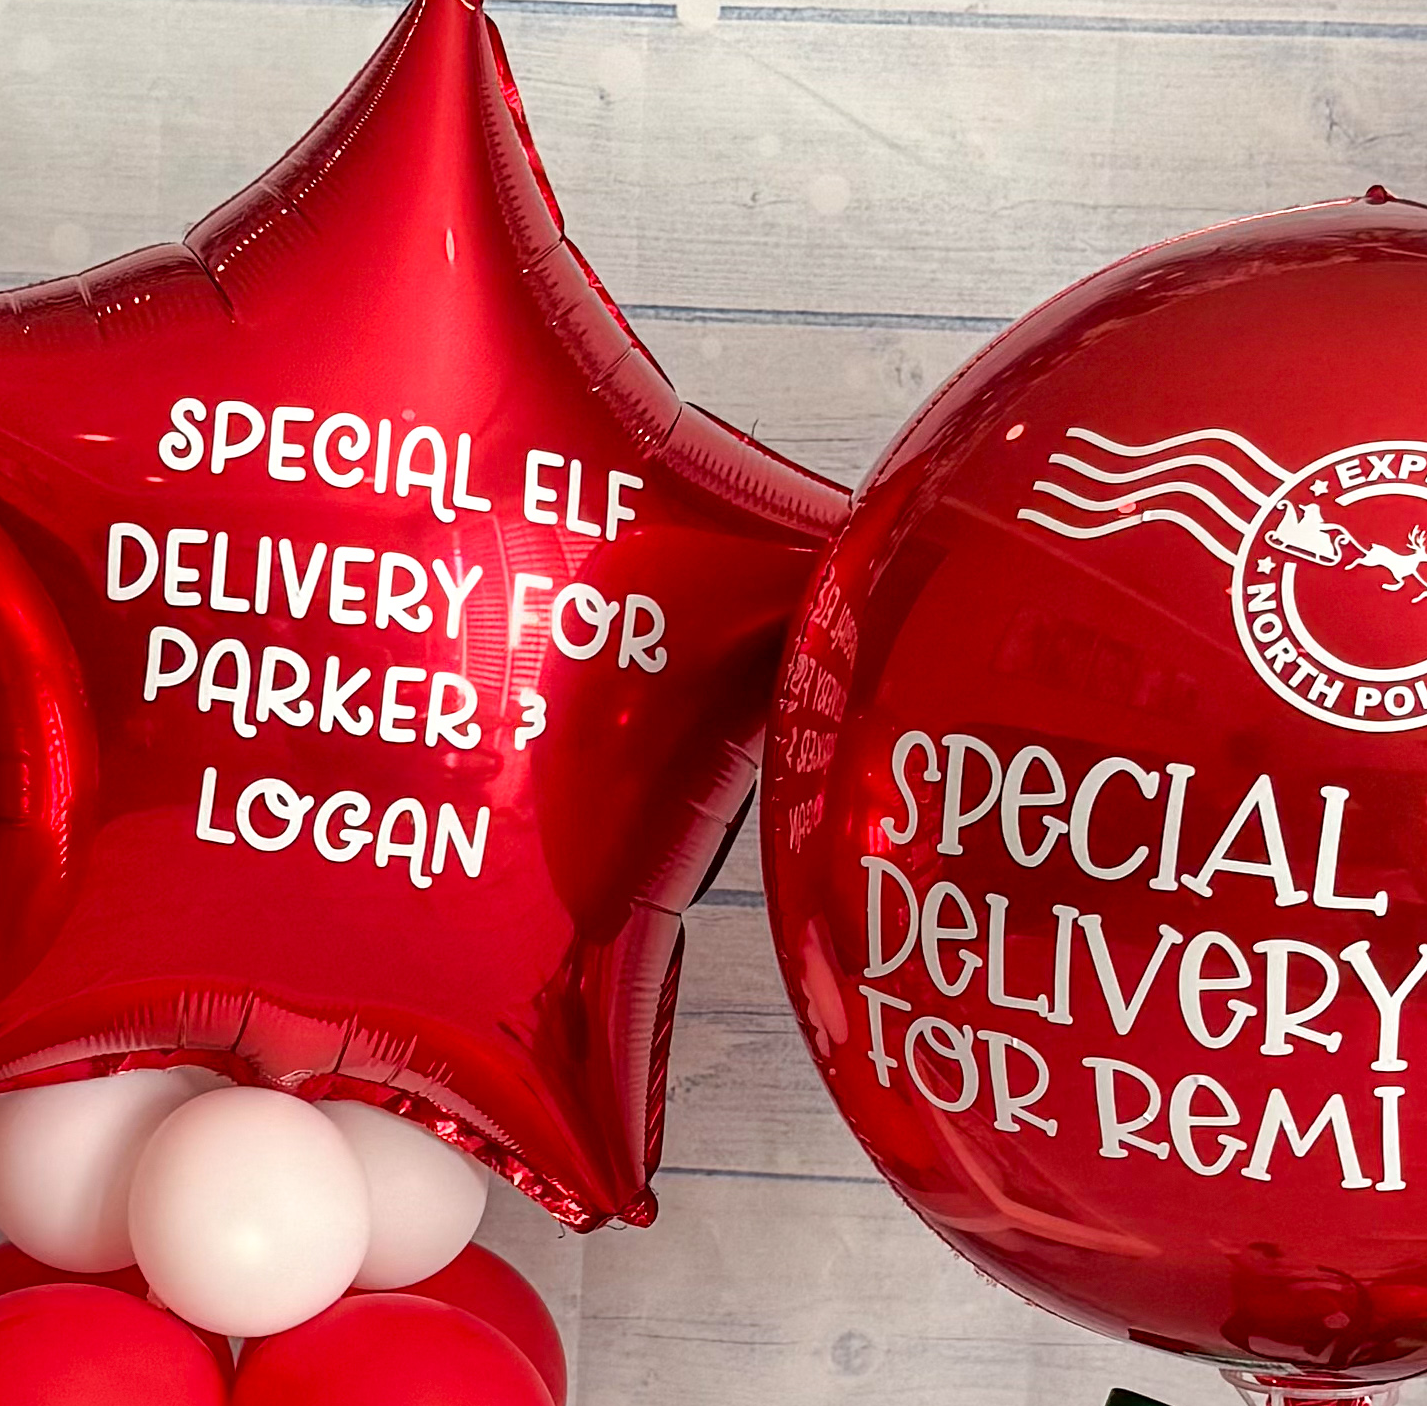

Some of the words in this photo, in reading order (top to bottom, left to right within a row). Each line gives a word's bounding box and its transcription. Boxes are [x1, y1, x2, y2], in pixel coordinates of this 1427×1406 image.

[158, 398, 491, 523] SPECIAL
[524, 450, 643, 540] ELF
[107, 523, 482, 639] DELIVERY
[509, 574, 667, 672] FOR
[1246, 582, 1344, 709] NORTH
[144, 627, 481, 750] PARKER
[196, 767, 490, 889] LOGAN
[860, 987, 1057, 1137] FOR
